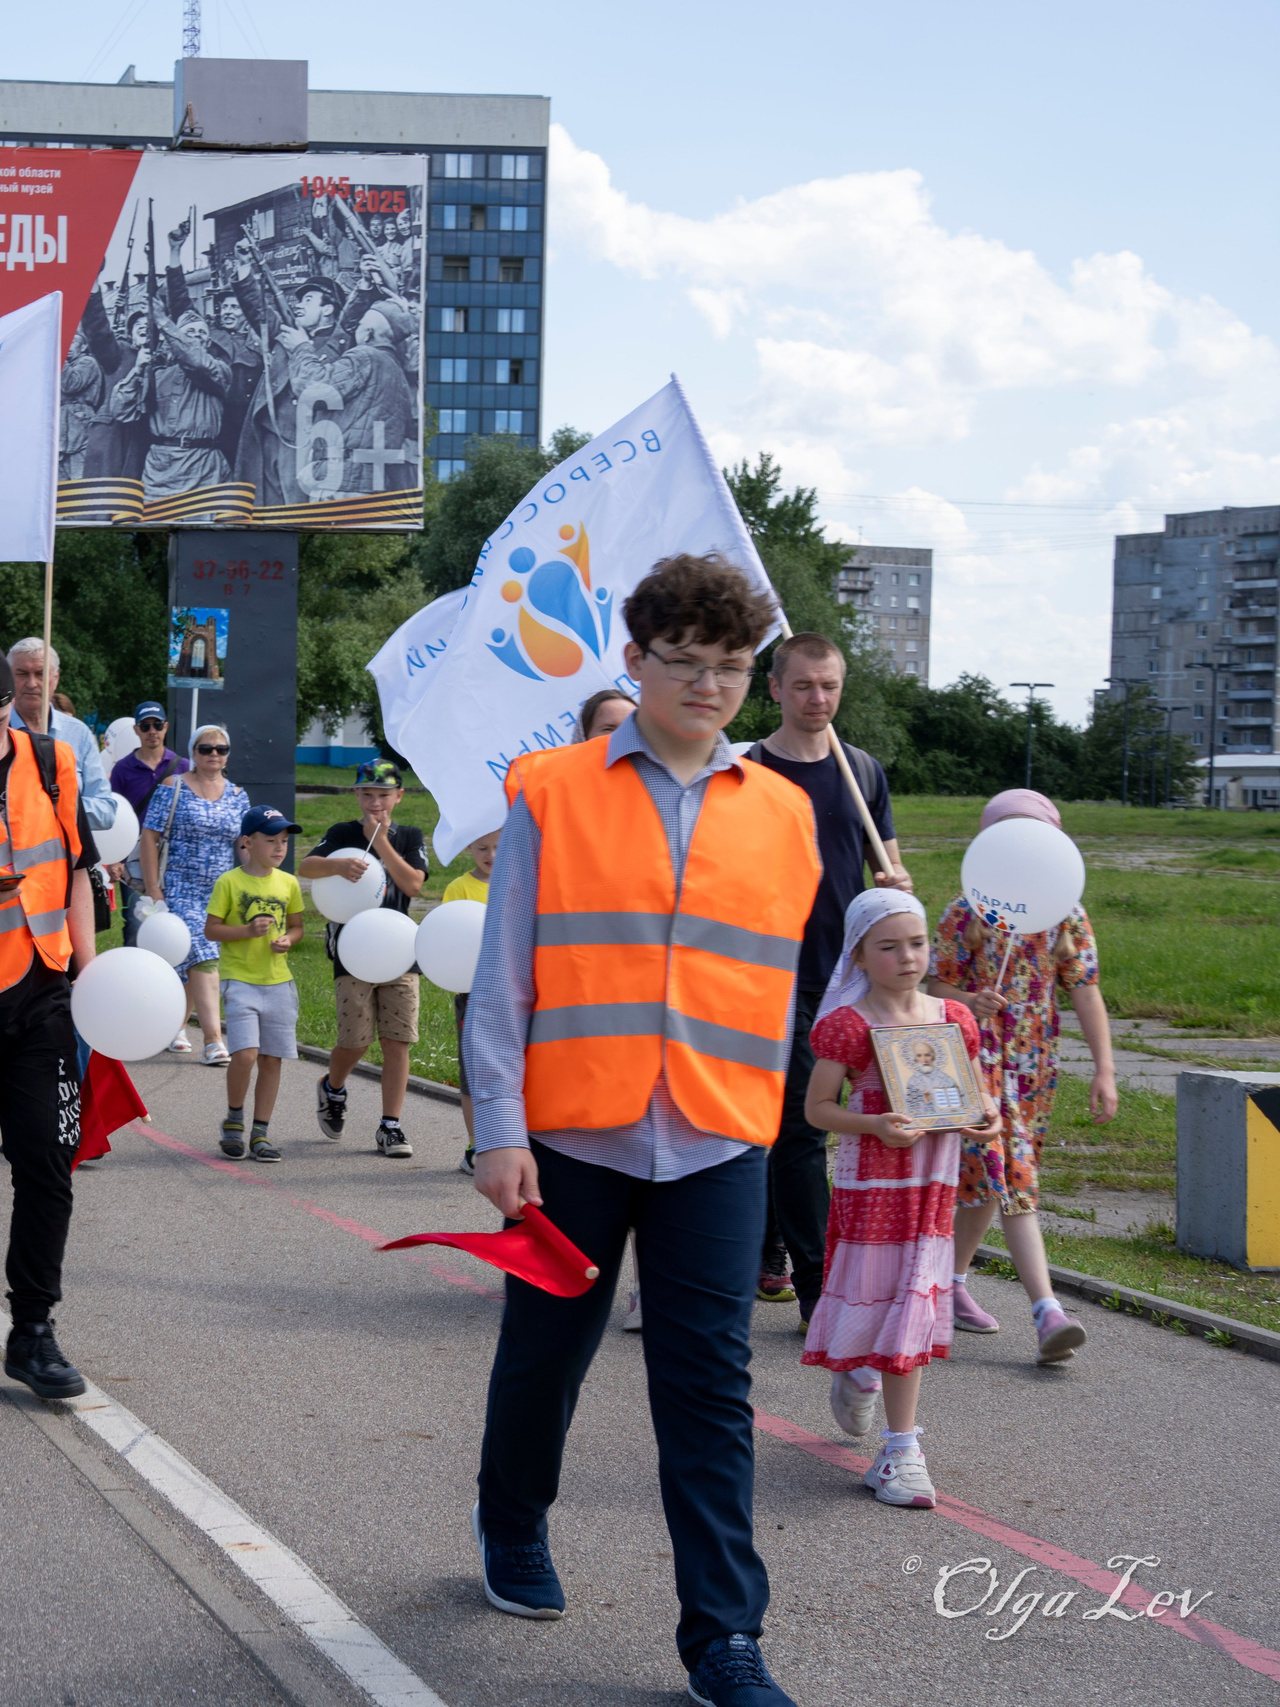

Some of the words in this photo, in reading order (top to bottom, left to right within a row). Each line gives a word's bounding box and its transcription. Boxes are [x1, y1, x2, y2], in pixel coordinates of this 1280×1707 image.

[18, 167, 61, 179] области
[21, 183, 54, 195] музей
[300, 176, 351, 199] 1945
[353, 190, 406, 214] 2025
[295, 382, 405, 498] 6+
[192, 559, 285, 581] 37-56-22
[971, 888, 1027, 915] ПАРАД
